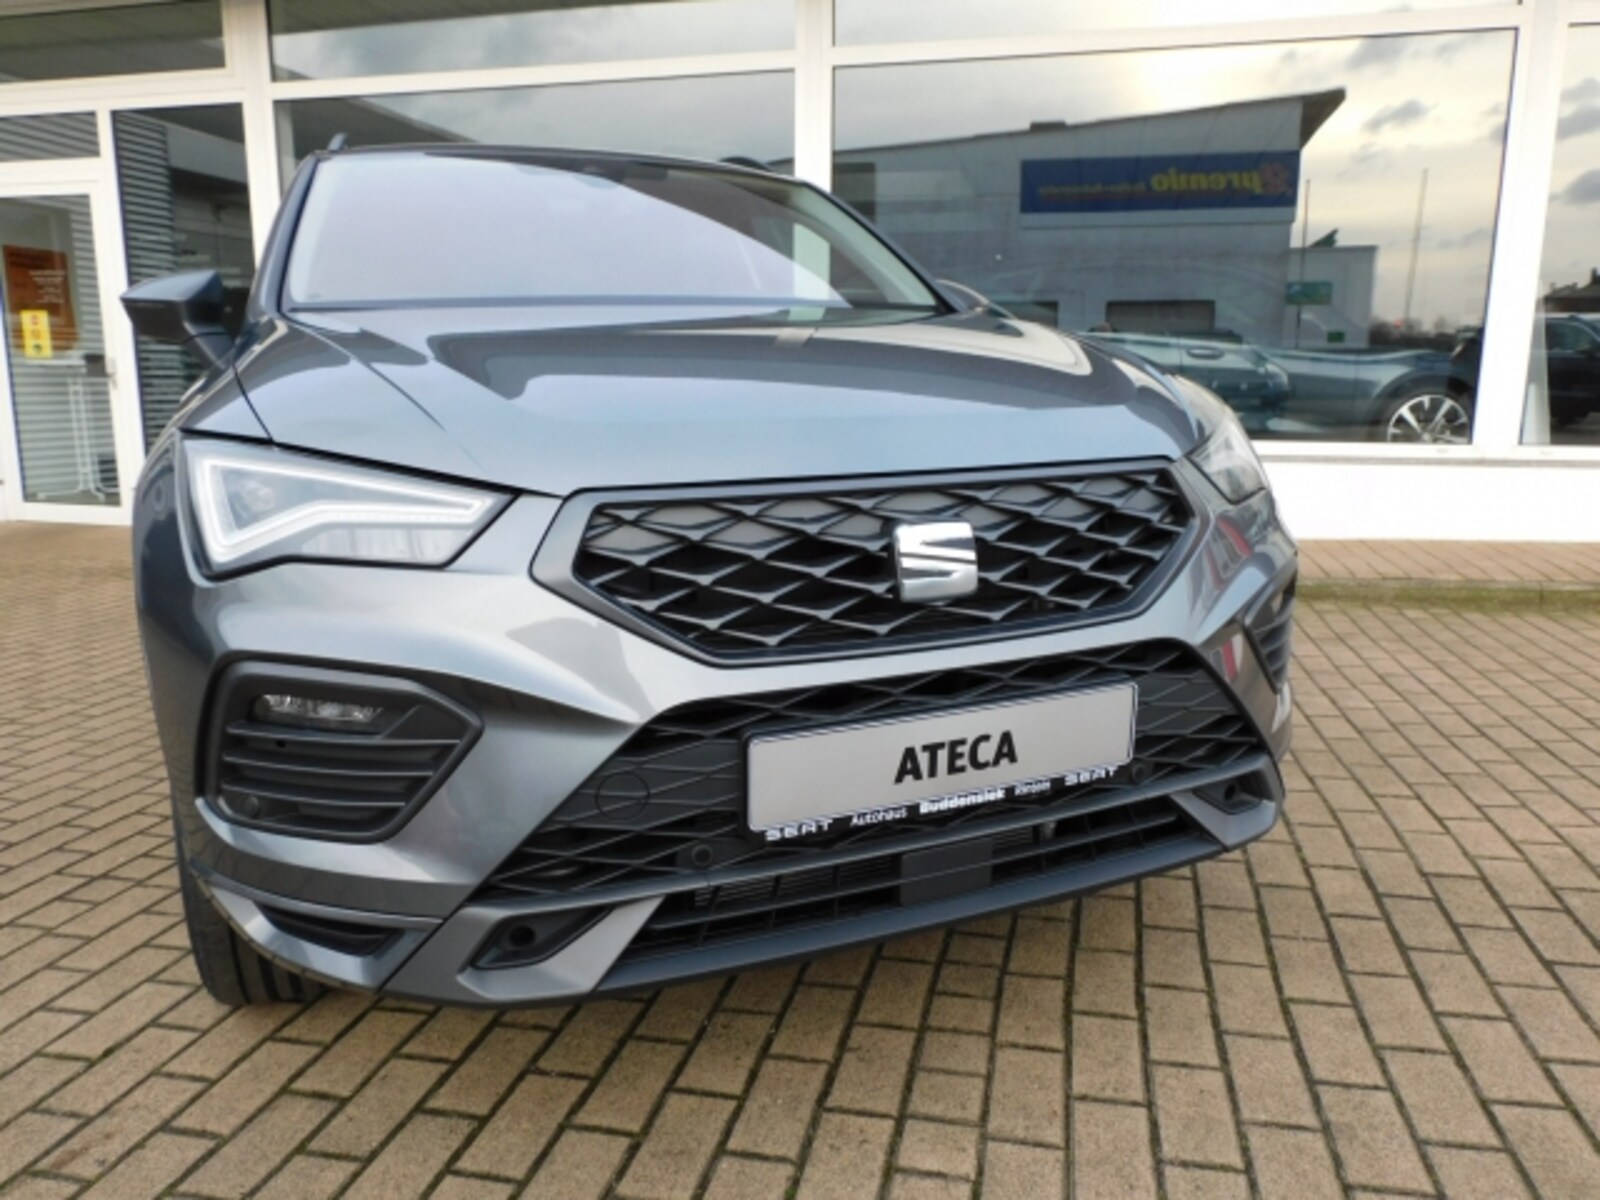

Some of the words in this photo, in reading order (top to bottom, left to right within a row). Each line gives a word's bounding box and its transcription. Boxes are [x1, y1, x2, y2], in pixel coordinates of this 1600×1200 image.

[894, 729, 1019, 785] ATECA
[764, 818, 833, 842] SEAT
[850, 805, 908, 828] Autohaus
[1064, 766, 1118, 787] SEAT
